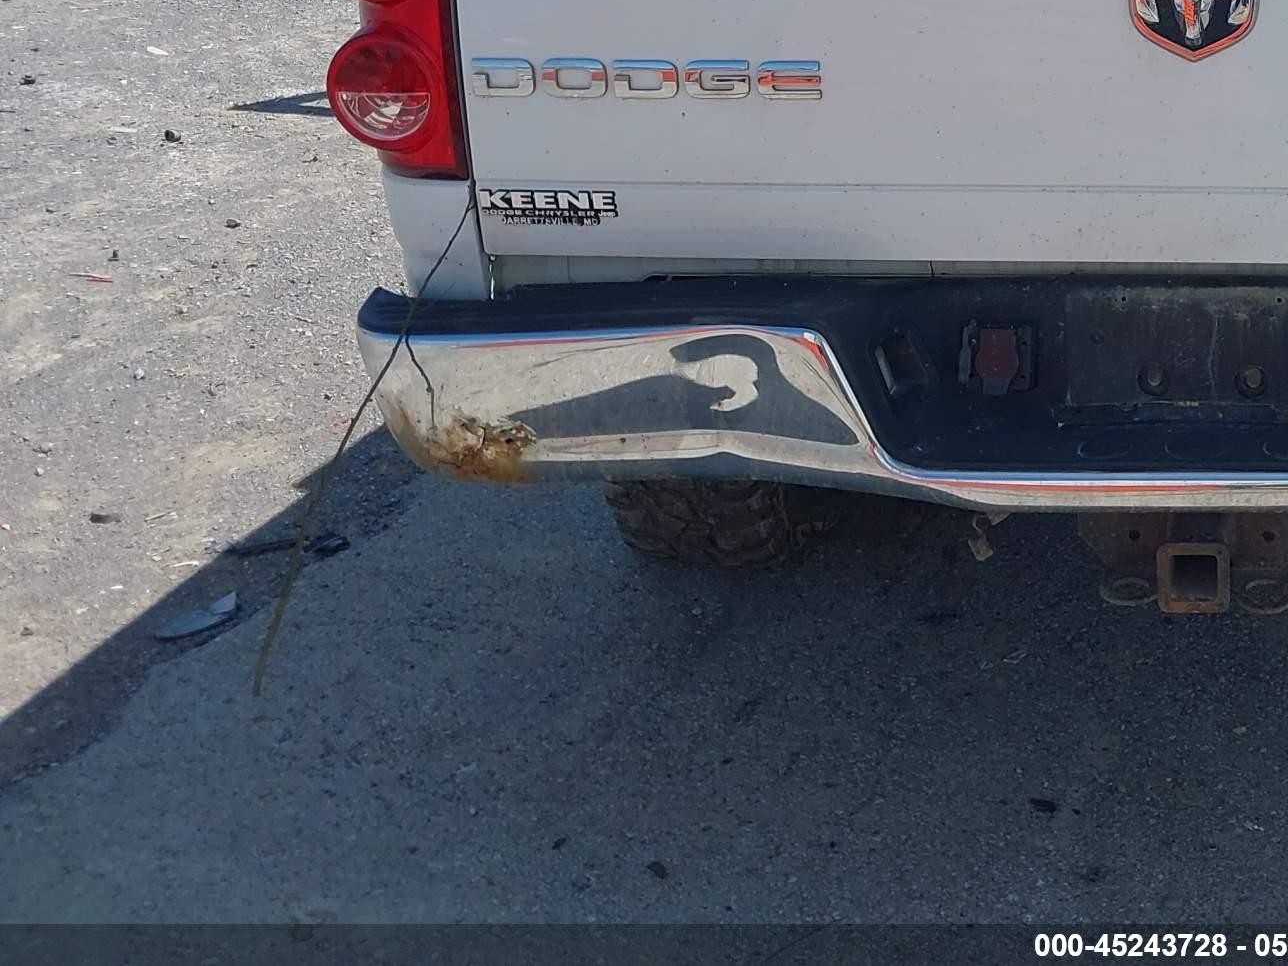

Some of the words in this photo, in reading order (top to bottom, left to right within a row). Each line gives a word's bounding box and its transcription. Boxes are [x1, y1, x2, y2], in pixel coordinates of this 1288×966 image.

[471, 57, 823, 100] DODGE
[479, 190, 616, 210] KEENE
[525, 209, 596, 217] CHRYSLER
[597, 209, 616, 218] Jeep
[583, 217, 600, 226] MD
